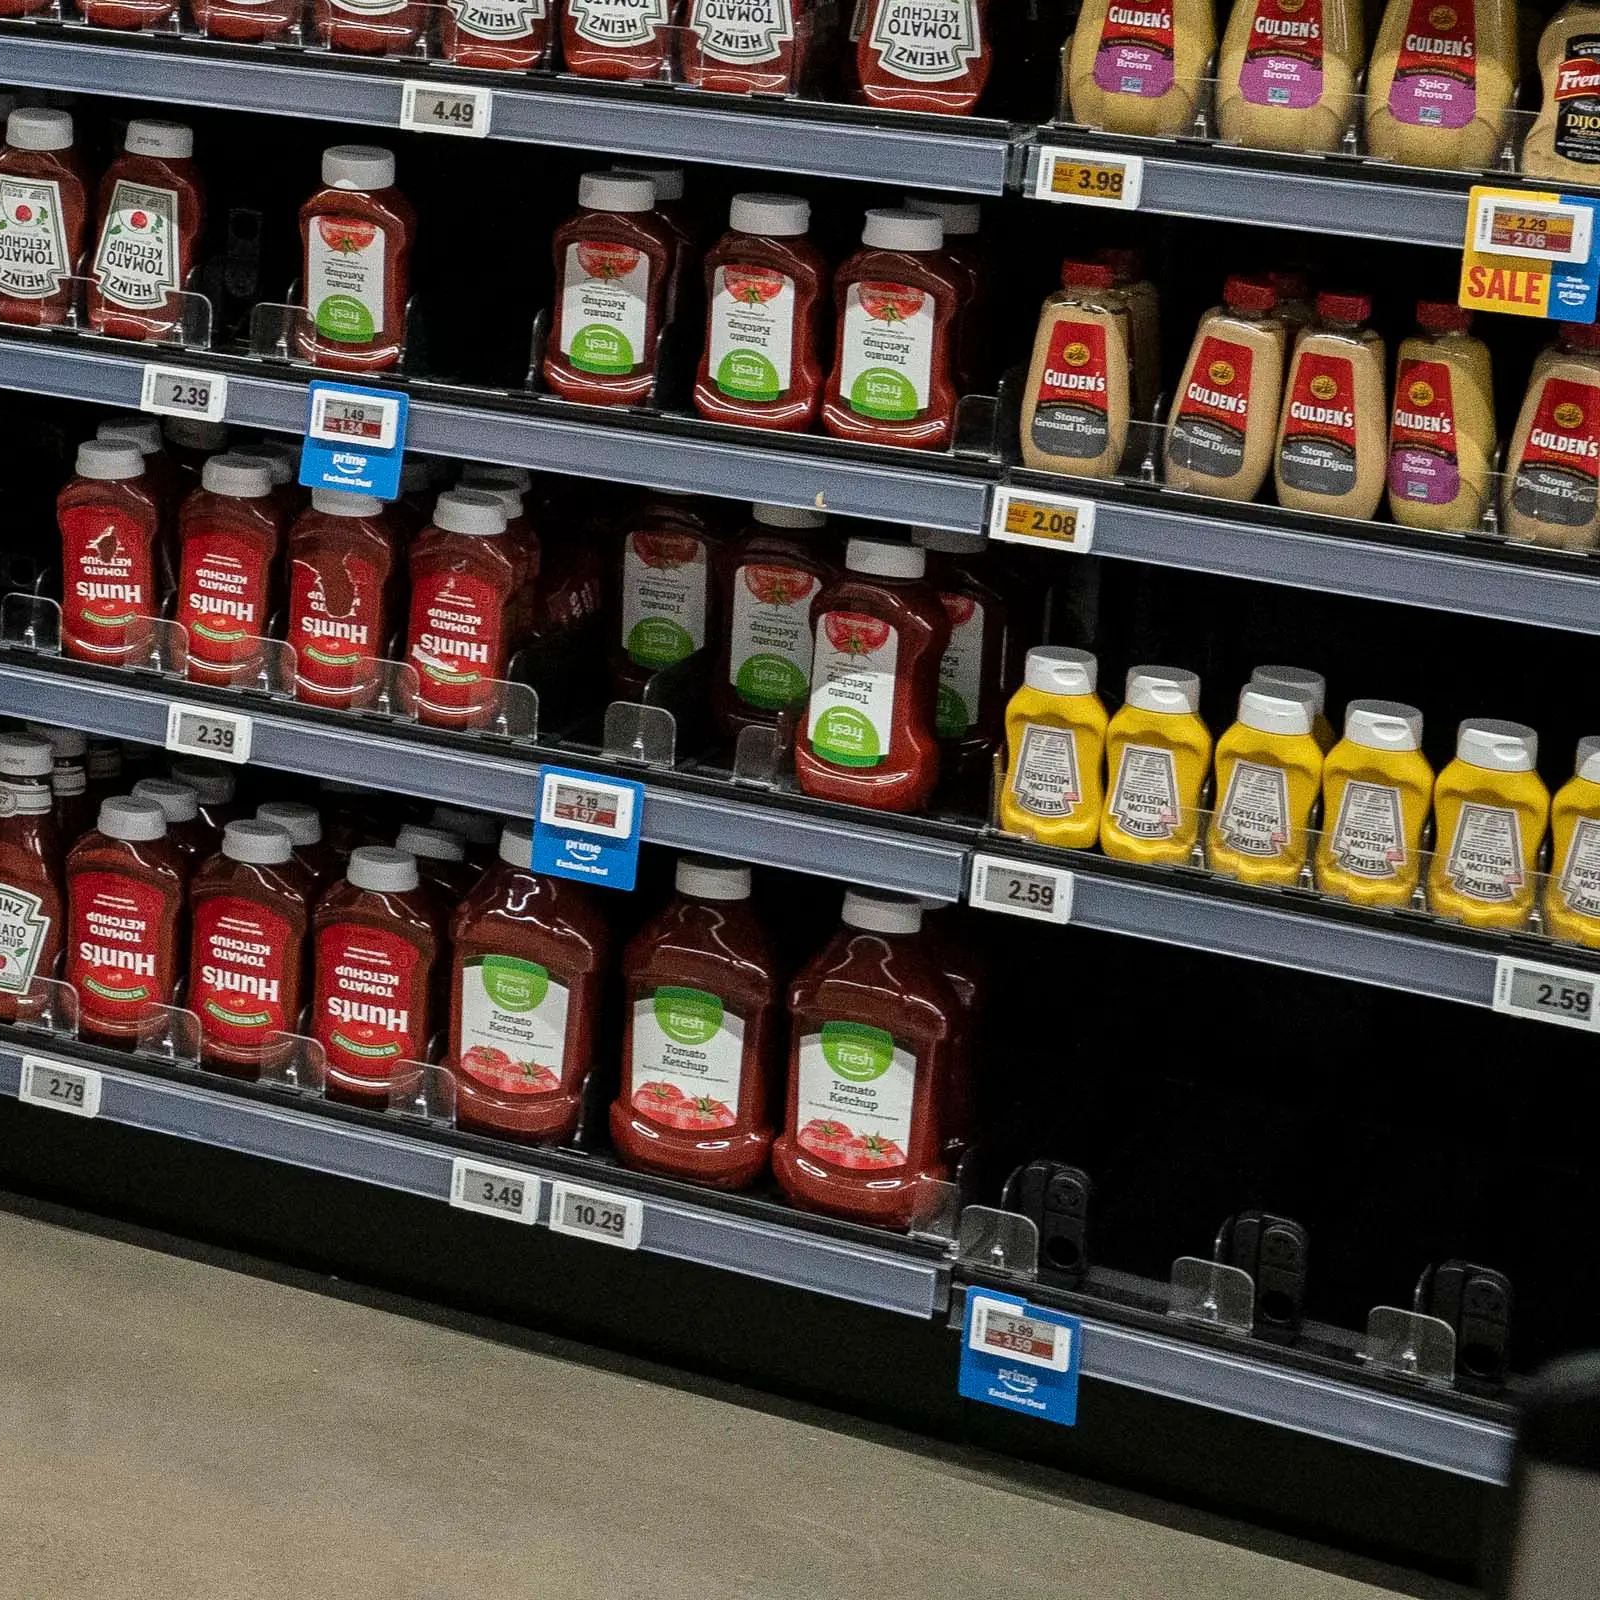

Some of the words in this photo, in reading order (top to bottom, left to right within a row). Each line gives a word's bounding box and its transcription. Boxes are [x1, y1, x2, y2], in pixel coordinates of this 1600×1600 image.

[468, 7, 518, 31] HEINZ
[1108, 5, 1171, 31] GULDEN'S
[1116, 58, 1153, 72] Brown
[1119, 48, 1151, 63] Spicy
[432, 101, 475, 124] 4.49
[1077, 169, 1124, 192] 3.98
[1467, 265, 1544, 305] SALE
[1044, 368, 1106, 394] GULDEN'S
[171, 385, 210, 406] 2.39
[1034, 417, 1077, 433] Ground
[1077, 423, 1107, 437] Dijon
[1053, 411, 1087, 425] Stone
[1031, 508, 1076, 536] 2.08
[197, 724, 234, 746] 2.39
[1008, 880, 1054, 905] 2.59
[837, 1047, 876, 1066] fresh
[49, 1077, 84, 1101] 2.79
[828, 1090, 879, 1111] Ketchup
[832, 1079, 877, 1099] Tomato
[481, 1181, 523, 1208] 3.49
[573, 1205, 626, 1232] 10.29
